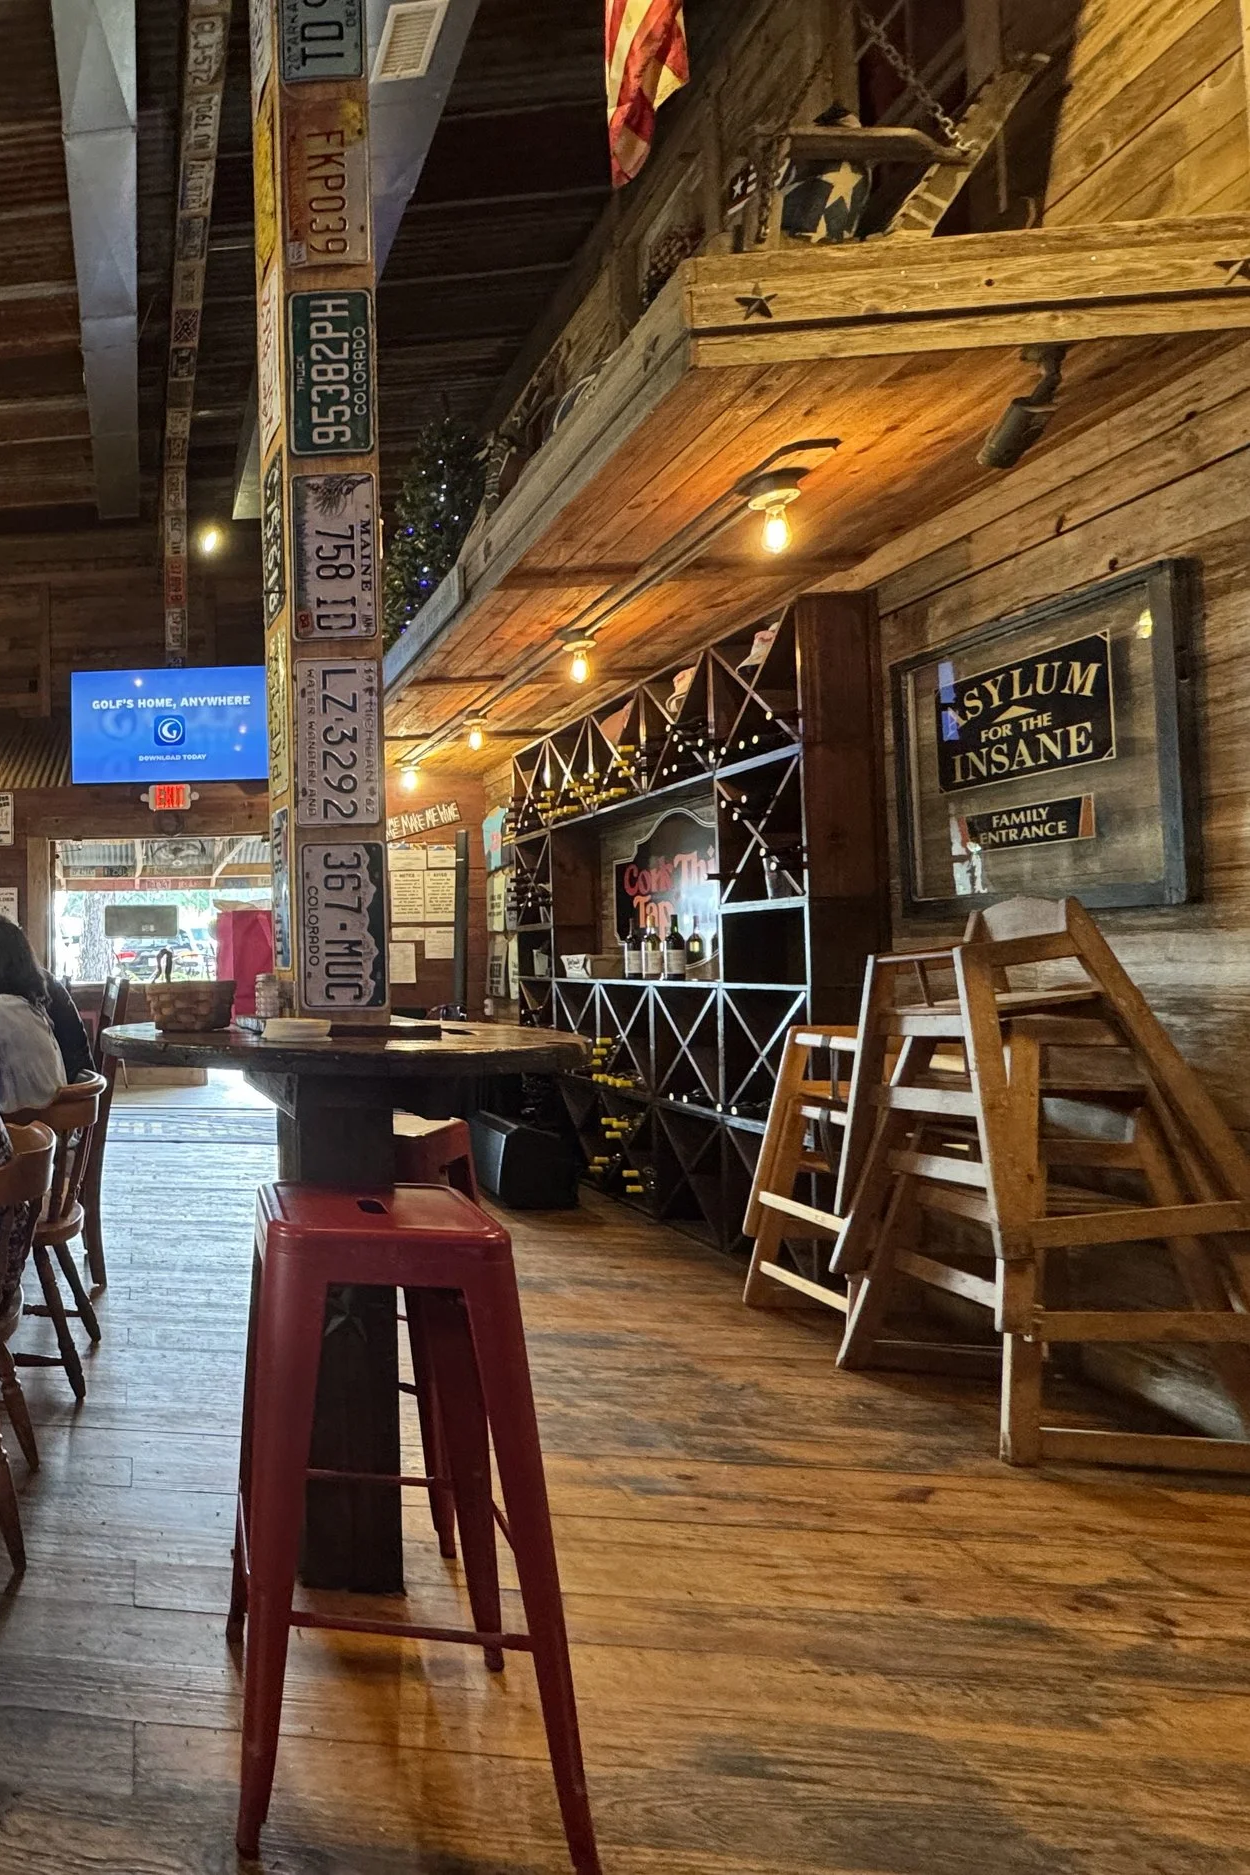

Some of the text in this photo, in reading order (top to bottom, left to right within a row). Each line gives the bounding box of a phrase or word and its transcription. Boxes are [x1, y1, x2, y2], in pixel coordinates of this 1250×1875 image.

[306, 129, 349, 257] FKP039
[296, 355, 306, 391] TRUCK
[310, 298, 352, 445] 95382PH
[352, 326, 367, 416] COLORADO
[315, 524, 357, 631] 758 ID
[359, 518, 373, 592] MAINE
[92, 695, 251, 710] GOLF'S HOME, ANYWHERE
[945, 661, 1102, 740] ASYLUM
[980, 711, 1053, 743] FOR THE
[138, 753, 207, 762] DOWNLOAD TODAY
[304, 668, 318, 818] WATER WONDERLAND
[365, 701, 377, 784] MICHIGAN
[952, 721, 1093, 784] INSANE
[156, 784, 185, 808] EXIT
[980, 820, 1068, 844] ENTRANCE
[992, 806, 1050, 828] FAMILY
[307, 885, 320, 967] COLORADO
